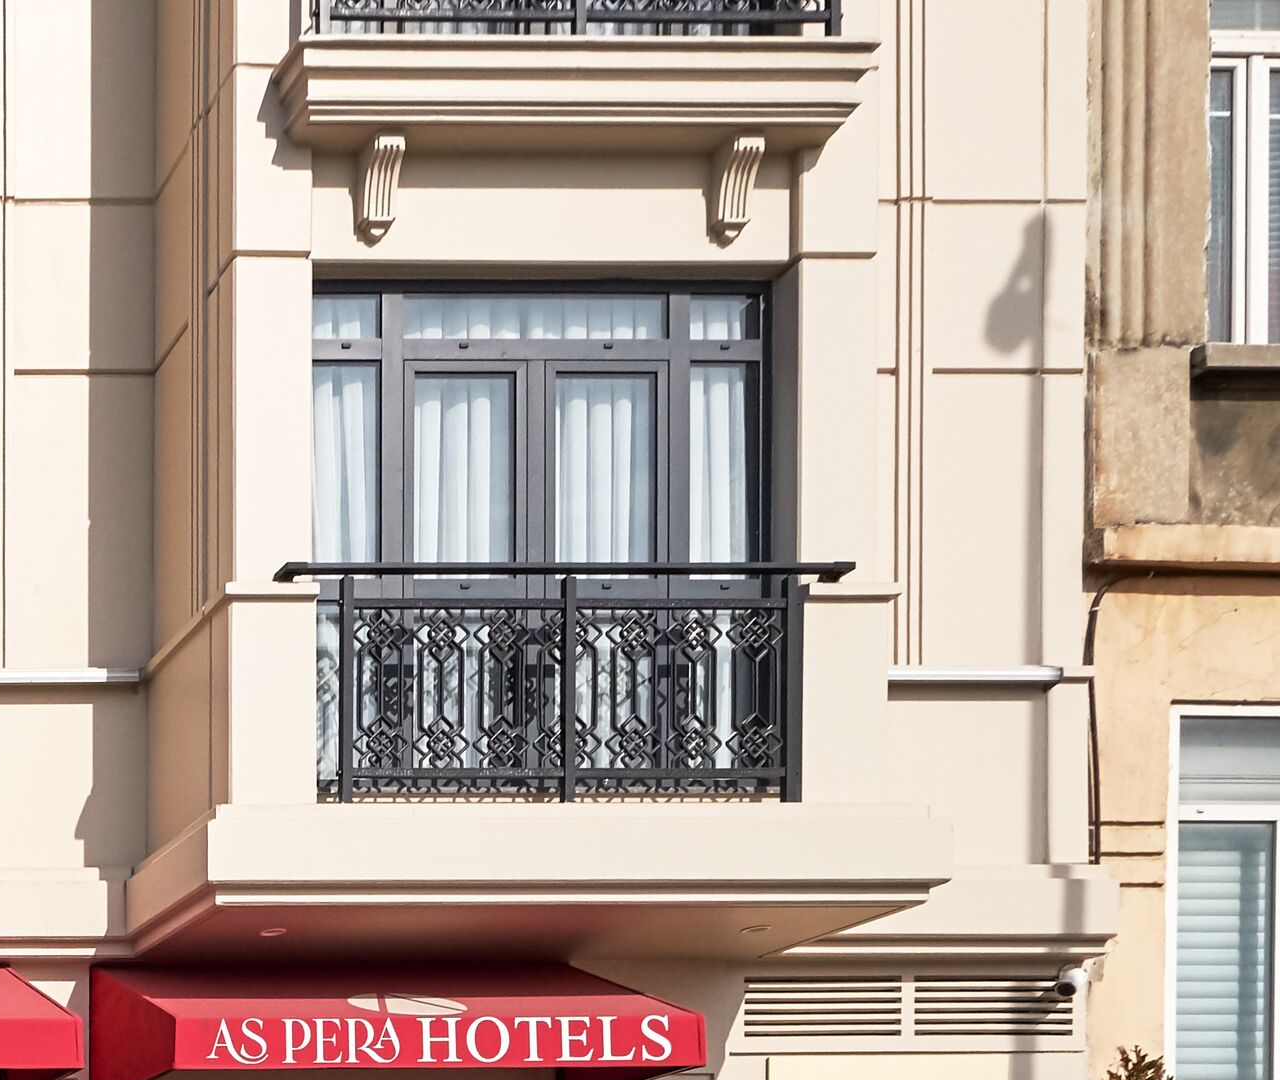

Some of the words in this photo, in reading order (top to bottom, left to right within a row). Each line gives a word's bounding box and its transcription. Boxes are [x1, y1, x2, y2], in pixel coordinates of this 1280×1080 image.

[206, 1017, 269, 1064] AS
[281, 1016, 401, 1064] PERA
[415, 1015, 672, 1063] HOTELS
